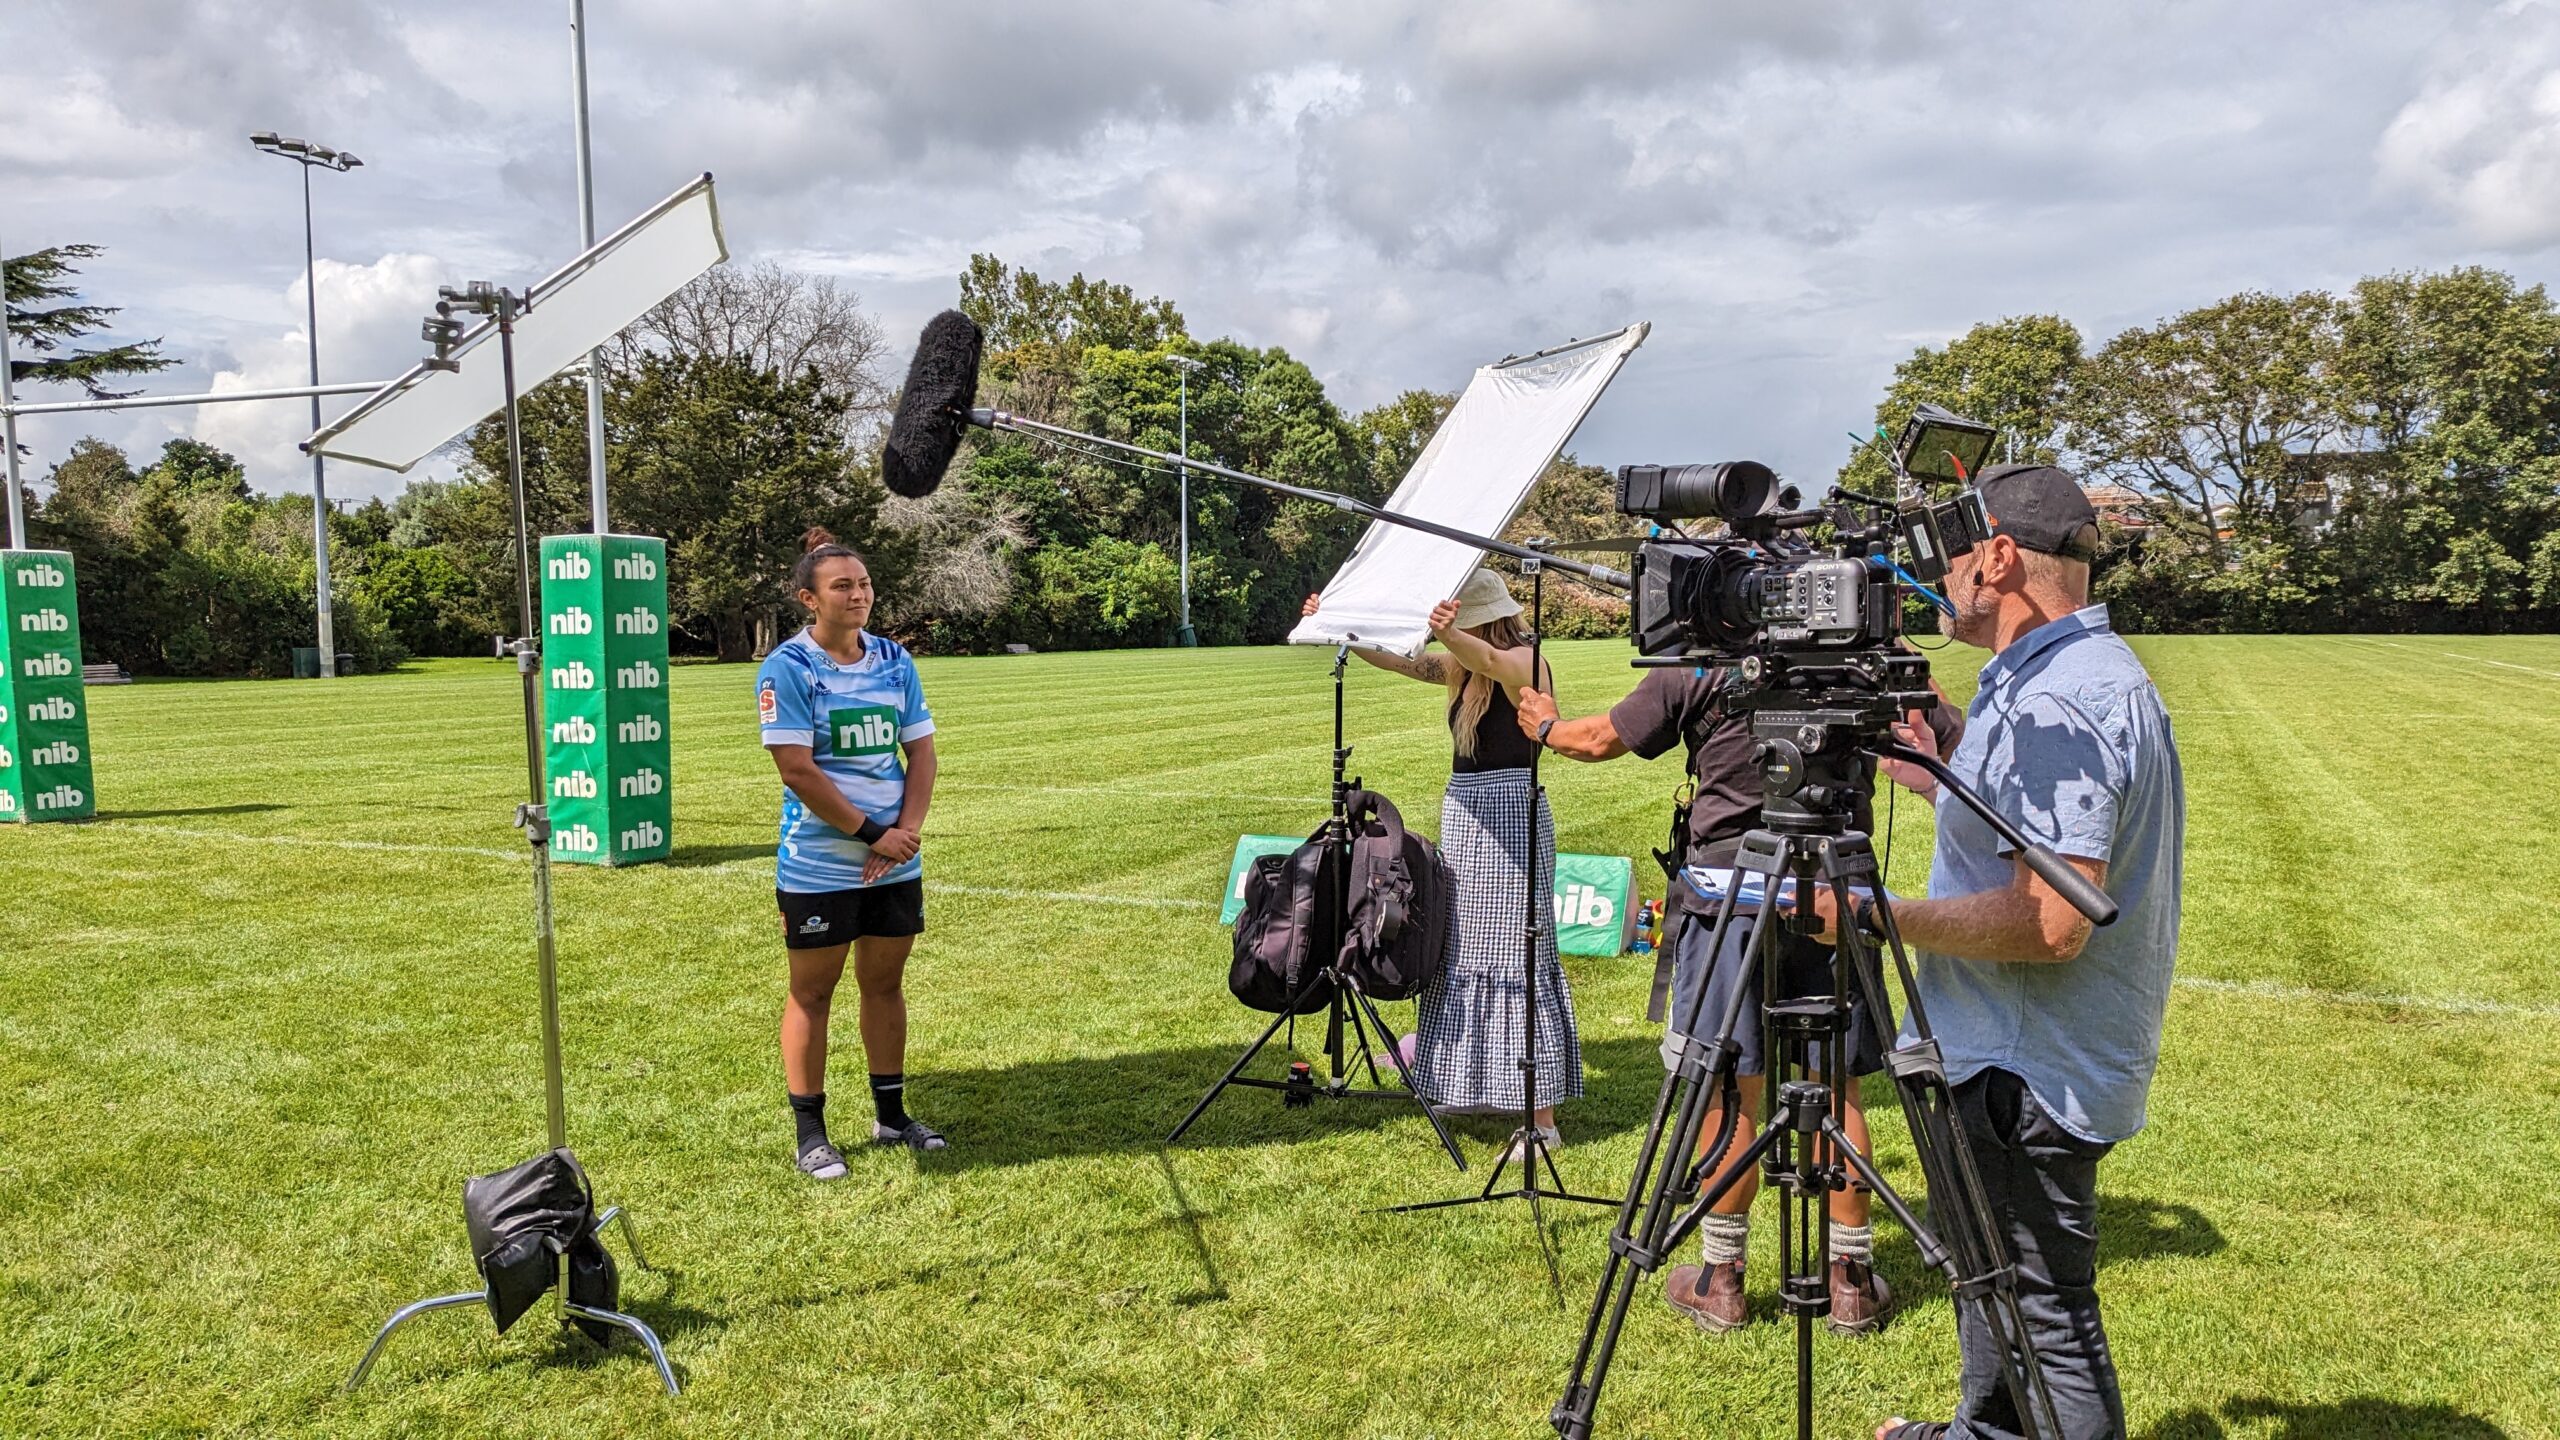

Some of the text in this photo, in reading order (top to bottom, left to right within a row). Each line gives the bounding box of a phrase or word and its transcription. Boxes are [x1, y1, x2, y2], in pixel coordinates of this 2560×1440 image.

[17, 564, 64, 587] nib
[549, 552, 591, 580] nib
[614, 553, 656, 580] nib
[1816, 563, 1841, 571] SONY
[21, 608, 68, 631] nib
[550, 607, 592, 634] nib
[616, 607, 658, 634] nib
[24, 653, 72, 676] nib
[552, 661, 594, 689] nib
[618, 661, 660, 688] nib
[29, 697, 75, 721] nib
[553, 716, 595, 744] nib
[619, 715, 661, 743] nib
[840, 714, 894, 748] nib
[33, 741, 79, 765] nib
[555, 771, 597, 798] nib
[620, 768, 662, 797] nib
[0, 789, 15, 811] ib
[36, 785, 83, 810] nib
[556, 824, 598, 852] nib
[622, 821, 663, 851] nib
